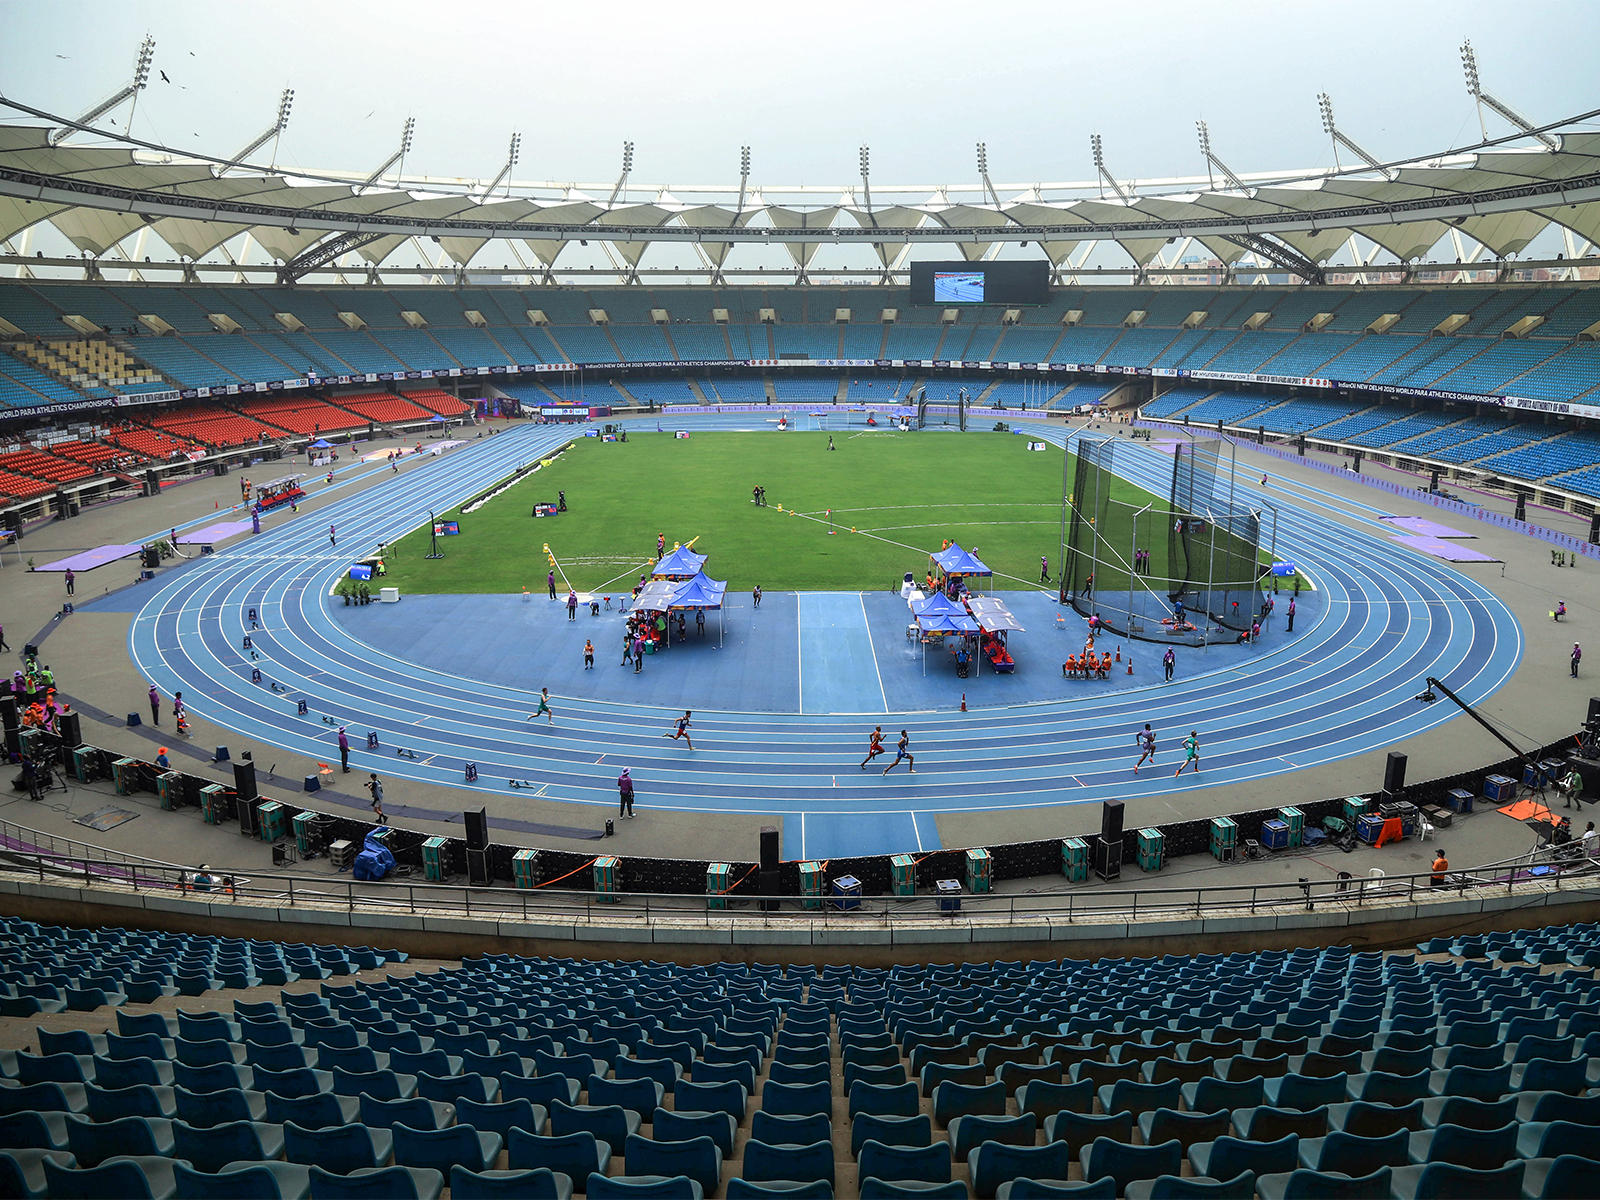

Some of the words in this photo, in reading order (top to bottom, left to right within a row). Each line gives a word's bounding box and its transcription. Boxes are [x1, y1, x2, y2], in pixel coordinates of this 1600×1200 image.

[1429, 391, 1456, 400] ATHLETICS
[1457, 394, 1499, 404] CHAMPIONSHIPS
[20, 408, 36, 416] PARA
[36, 403, 67, 414] ATHLETICS
[68, 399, 112, 410] CHAMPIONSHIPS
[1517, 399, 1532, 408] SPORTS
[1532, 400, 1553, 410] AUTHORITY
[1558, 404, 1569, 413] INDIA
